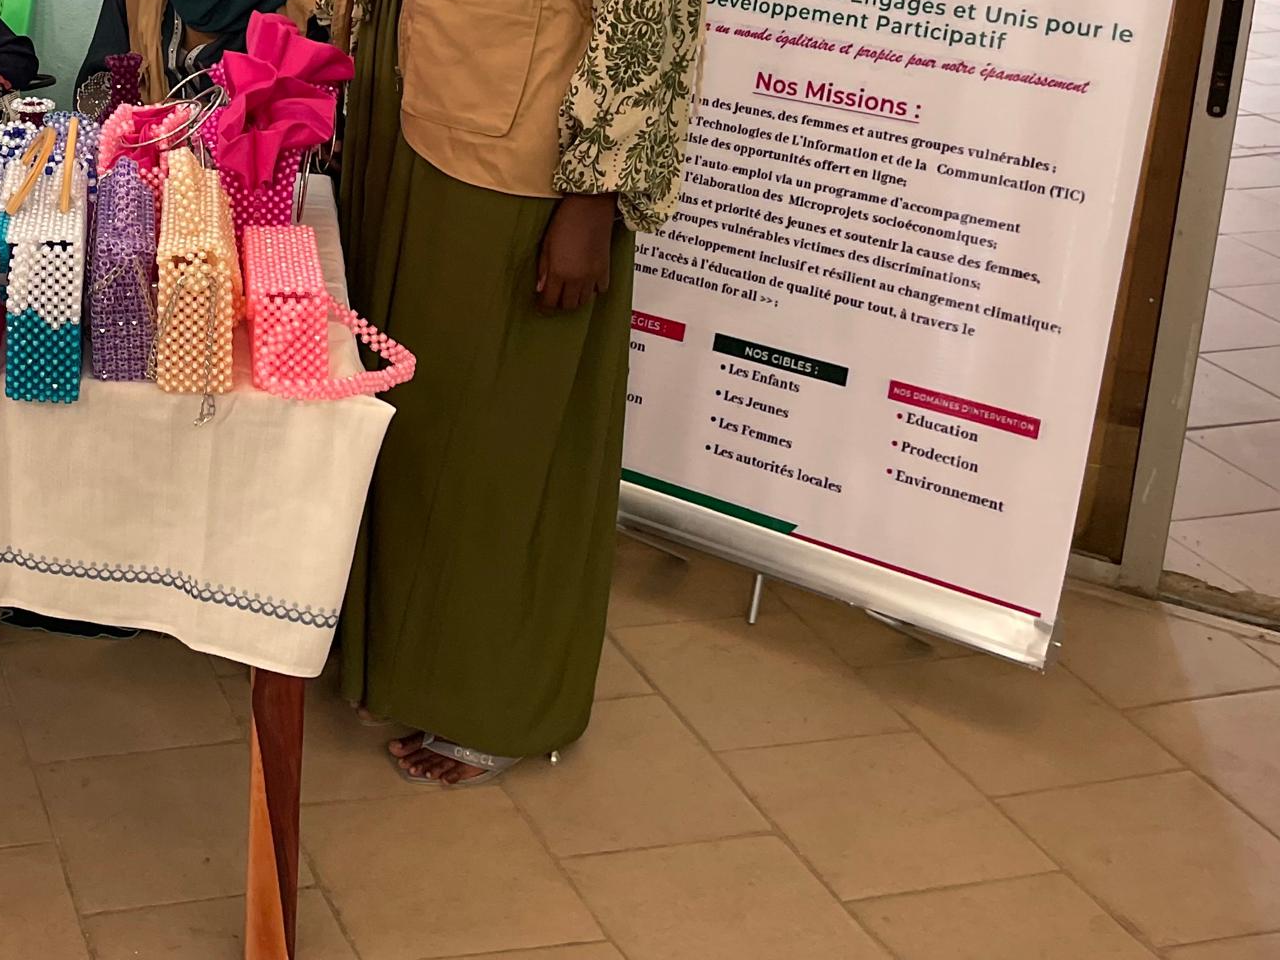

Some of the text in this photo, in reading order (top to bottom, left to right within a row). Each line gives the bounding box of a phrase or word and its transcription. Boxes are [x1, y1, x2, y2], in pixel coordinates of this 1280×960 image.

[876, 15, 1007, 49] Participatif
[954, 4, 976, 20] et
[986, 6, 1038, 29] Unis
[1045, 18, 1103, 37] pour
[1112, 23, 1133, 43] le
[716, 24, 729, 35] un
[734, 27, 772, 41] monde
[776, 30, 835, 52] égalitaire
[839, 43, 852, 55] et
[854, 46, 903, 64] propice
[905, 53, 936, 69] pour
[941, 60, 976, 75] notre
[980, 63, 1090, 94] épanouissement
[755, 71, 907, 116] Nos Missions
[712, 98, 732, 113] des
[733, 101, 775, 120] jeunes,
[778, 111, 798, 124] des
[801, 115, 849, 134] femmes
[852, 126, 864, 136] et
[867, 129, 908, 144] autres
[911, 138, 964, 155] groupes
[968, 148, 1050, 172] vulnérables
[696, 116, 772, 141] Technologies
[775, 131, 790, 144] de
[792, 135, 878, 162] L'information
[881, 153, 893, 164] et
[896, 156, 912, 167] de
[915, 159, 927, 171] la
[937, 163, 1045, 195] Communication
[1049, 185, 1085, 204] (TIC)
[711, 137, 731, 152] des
[733, 143, 811, 168] opportunités
[814, 158, 850, 175] offert
[853, 167, 868, 178] en
[872, 169, 907, 188] ligne;
[685, 171, 997, 250] l'élaboration des Microprojets socioéconomiques;
[775, 174, 793, 187] via
[796, 178, 811, 190] un
[814, 182, 887, 206] programme
[890, 197, 1021, 234] d'accompagnement
[672, 211, 981, 291] groupes vulnérables victimes des discriminations;
[701, 199, 713, 209] et
[715, 201, 761, 219] priorité
[763, 212, 784, 225] des
[785, 215, 827, 235] jeunes
[829, 227, 842, 238] et
[844, 229, 898, 251] soutenir
[901, 241, 913, 255] la
[916, 247, 954, 264] cause
[958, 254, 981, 270] des
[984, 260, 1041, 284] femmes,
[651, 246, 689, 265] l'accès
[691, 256, 698, 268] à
[700, 258, 766, 285] l'éducation
[769, 276, 784, 289] de
[786, 281, 831, 301] qualité
[833, 292, 865, 310] pour
[868, 301, 897, 319] tout,
[910, 311, 959, 333] travers
[962, 323, 975, 337] le
[660, 267, 719, 292] Education
[721, 283, 739, 297] for
[741, 288, 757, 302] all
[668, 230, 756, 260] développement
[759, 252, 807, 272] inclusif
[807, 263, 820, 275] et
[822, 266, 876, 289] résilient
[879, 280, 894, 293] au
[897, 284, 981, 314] changement
[983, 305, 1062, 335] climatique;
[728, 363, 801, 393] Les Enfants
[744, 346, 812, 373] NOS CIBLES
[723, 389, 790, 419] Les Jeunes
[893, 387, 912, 397] NOS
[913, 392, 960, 411] DOMAINES
[718, 417, 793, 449] Les Femmes
[906, 411, 979, 442] Education
[713, 443, 842, 493] Les autorités locales
[901, 440, 978, 473] Prodection
[895, 469, 1004, 512] Environnement
